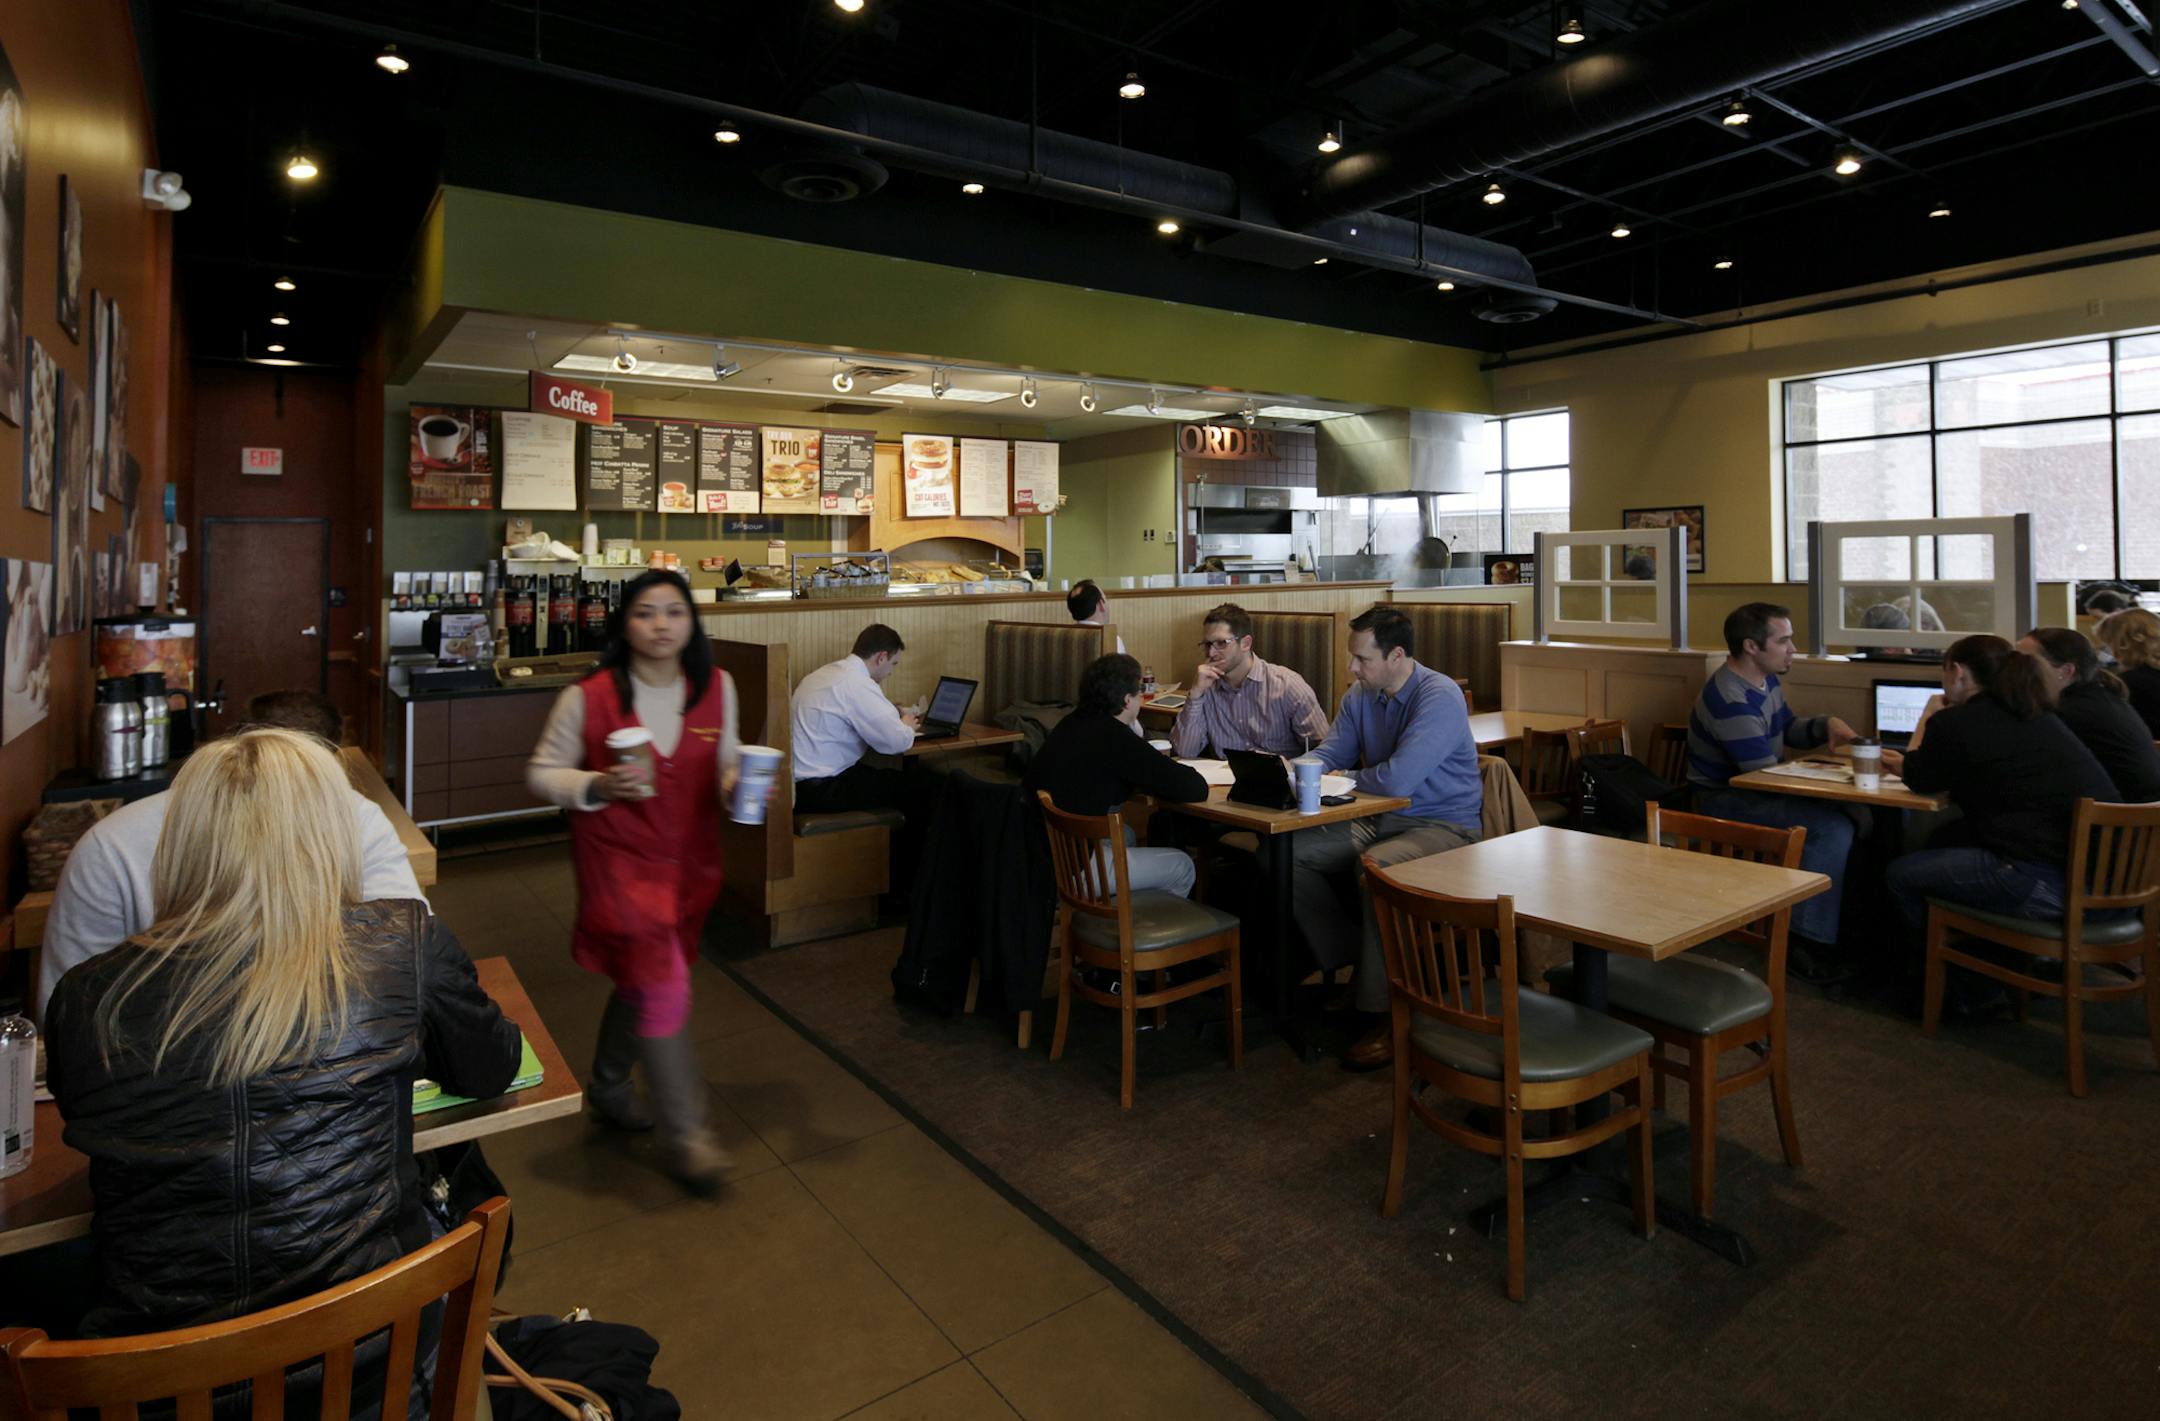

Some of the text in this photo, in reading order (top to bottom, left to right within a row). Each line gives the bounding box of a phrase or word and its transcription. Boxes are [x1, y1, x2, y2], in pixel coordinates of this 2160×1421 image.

[549, 386, 598, 416] Coffee
[771, 440, 800, 456] TRIO
[1180, 424, 1276, 457] ORDER
[249, 448, 277, 467] EXIT
